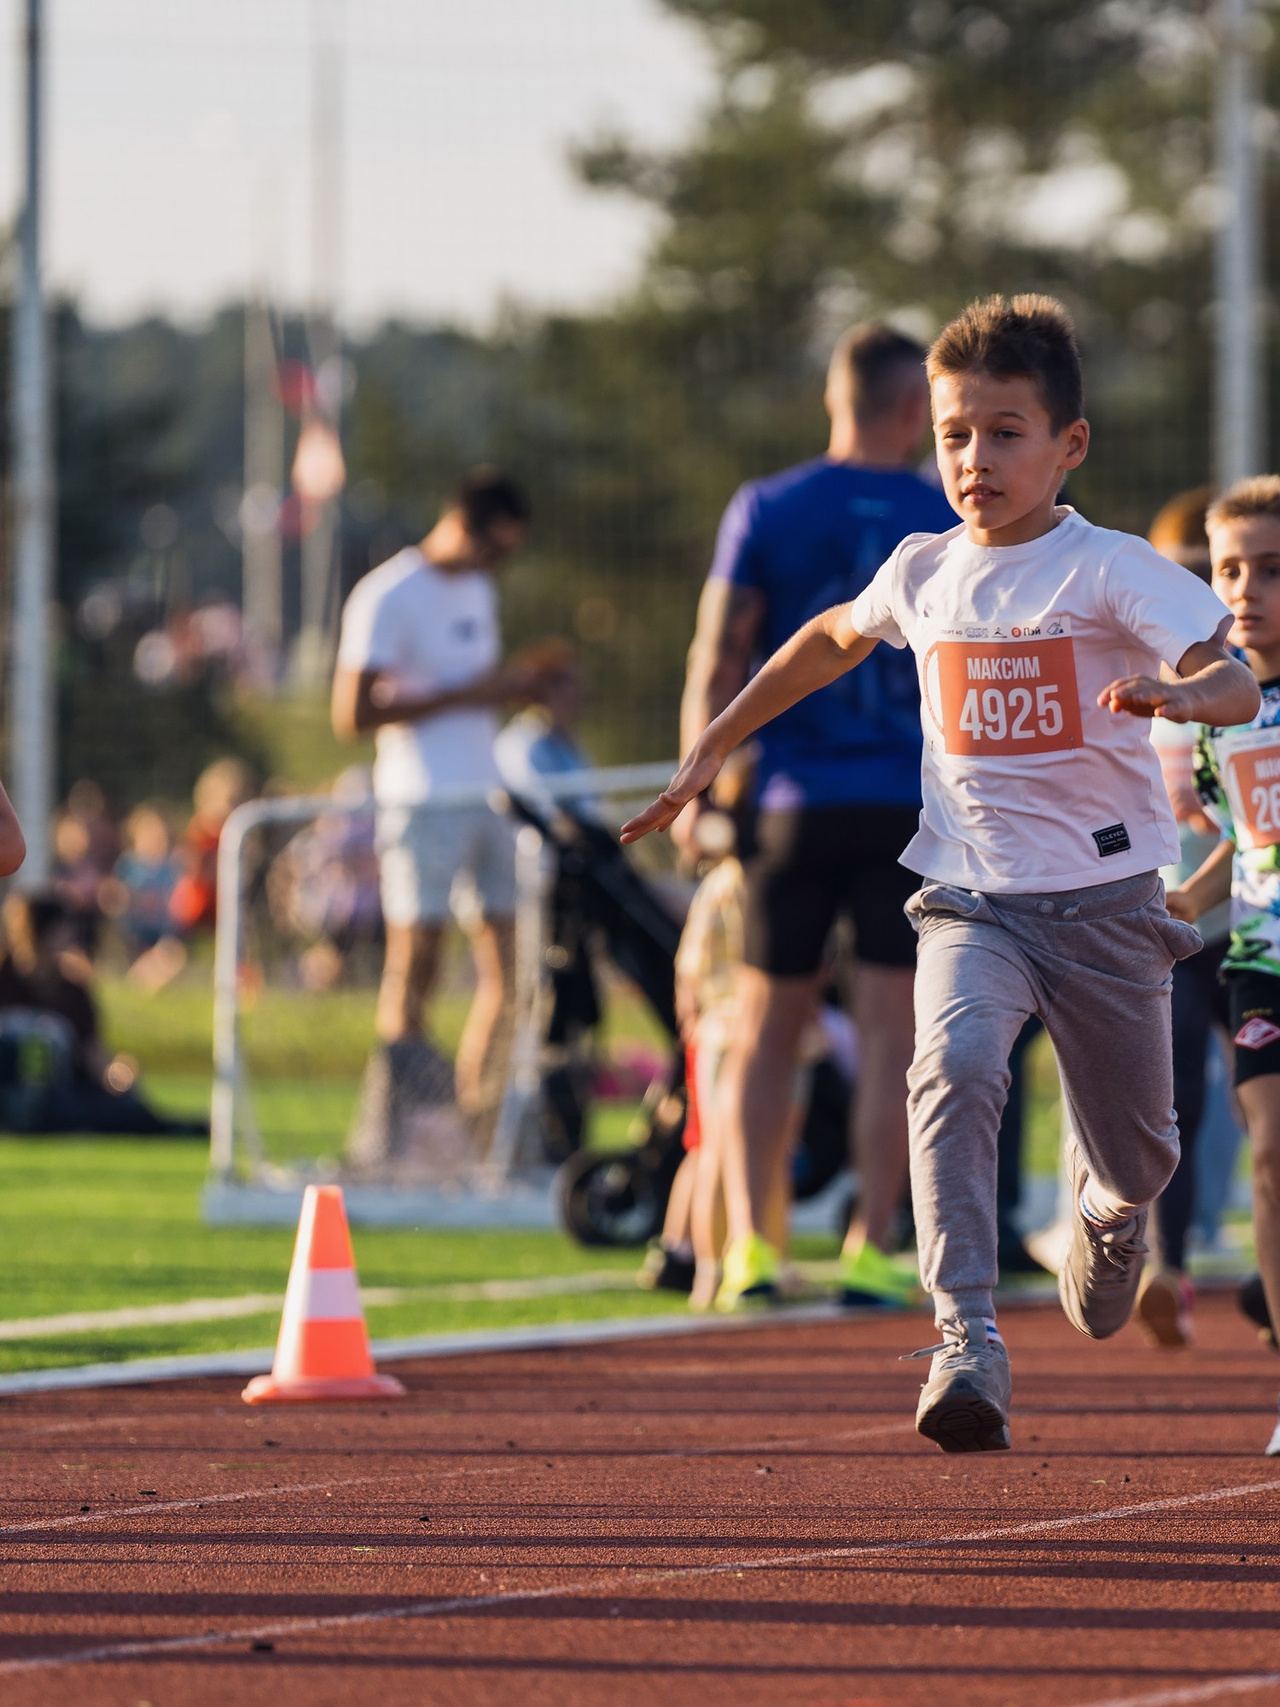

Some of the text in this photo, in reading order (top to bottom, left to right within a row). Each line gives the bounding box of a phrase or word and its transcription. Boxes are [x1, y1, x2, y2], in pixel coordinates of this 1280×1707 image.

[1023, 626, 1041, 637] Пэй
[966, 656, 1041, 680] МАКСИМ
[959, 685, 1063, 741] 4925
